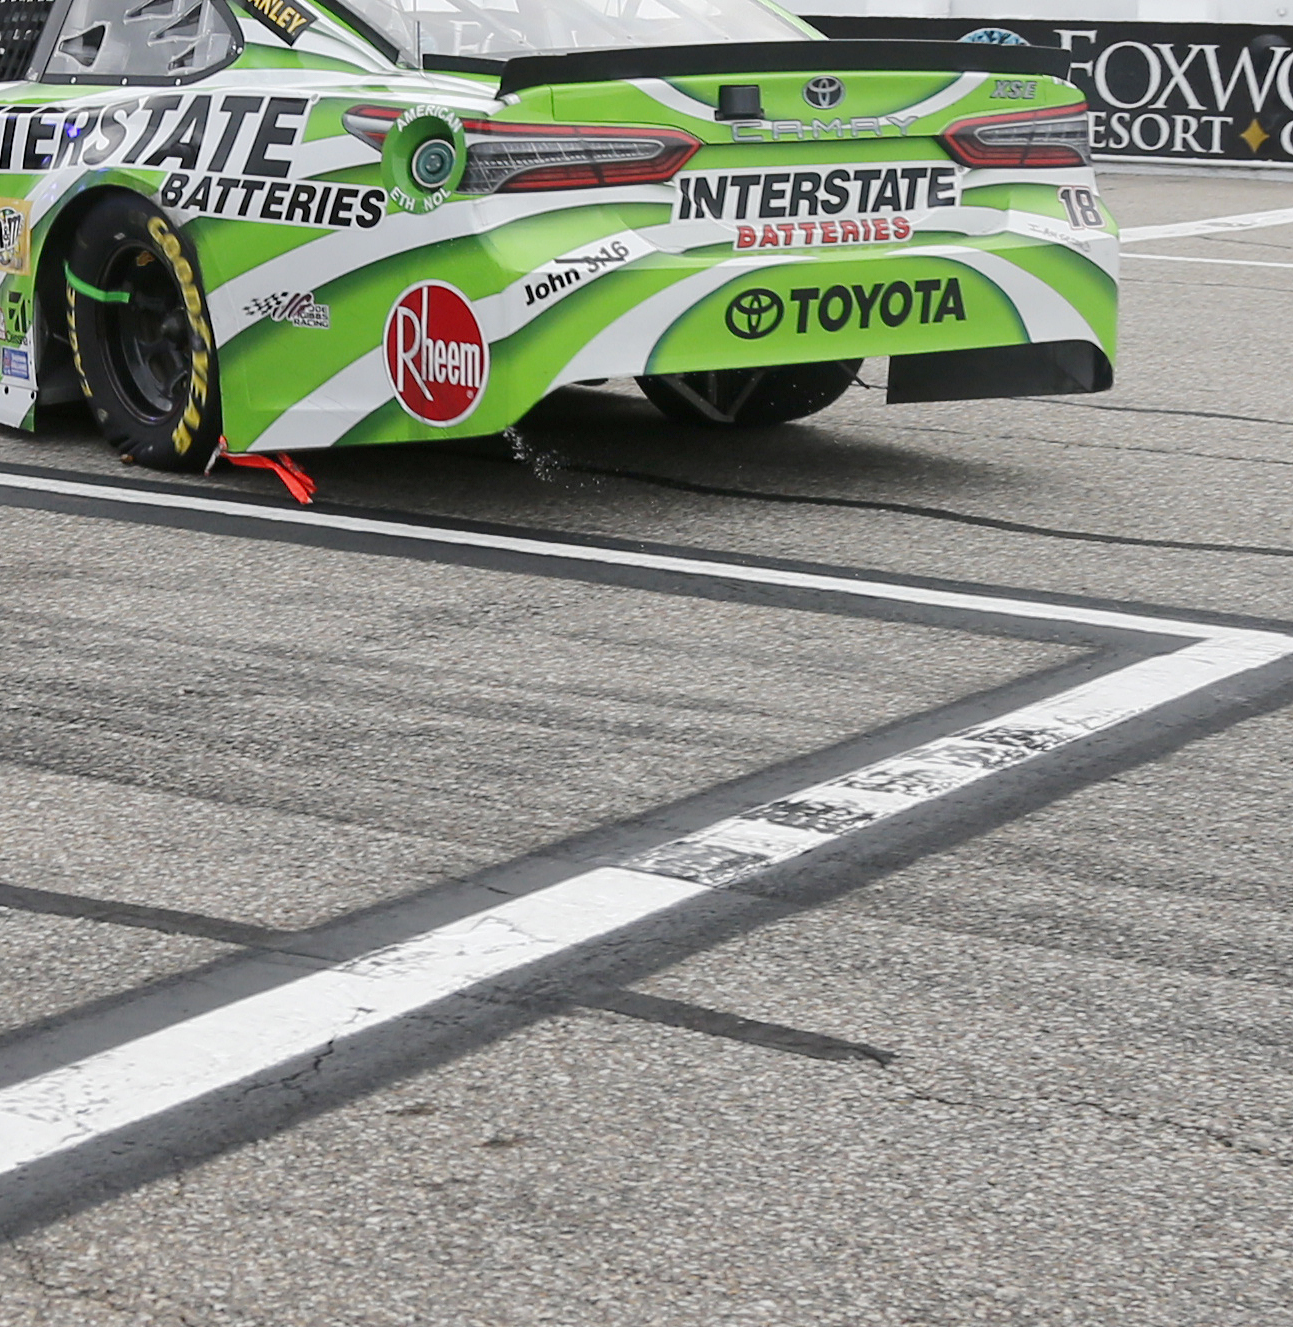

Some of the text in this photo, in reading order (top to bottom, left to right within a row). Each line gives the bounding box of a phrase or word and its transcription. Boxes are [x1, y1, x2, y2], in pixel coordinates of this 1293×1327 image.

[990, 79, 1037, 100] XSE
[1053, 29, 1293, 113] FOXW
[396, 104, 464, 133] AMERICAN
[730, 115, 919, 143] CAMRY
[1088, 111, 1233, 154] ESORT
[161, 174, 386, 228] BATTERIES
[390, 186, 452, 212] ETHNOL
[678, 167, 957, 220] INTERSTATE
[1058, 186, 1105, 229] 18
[736, 216, 911, 249] BATTERIES
[524, 269, 581, 306] John
[791, 278, 966, 334] TOYOTA
[294, 319, 329, 328] RACING
[396, 286, 481, 402] Rheem
